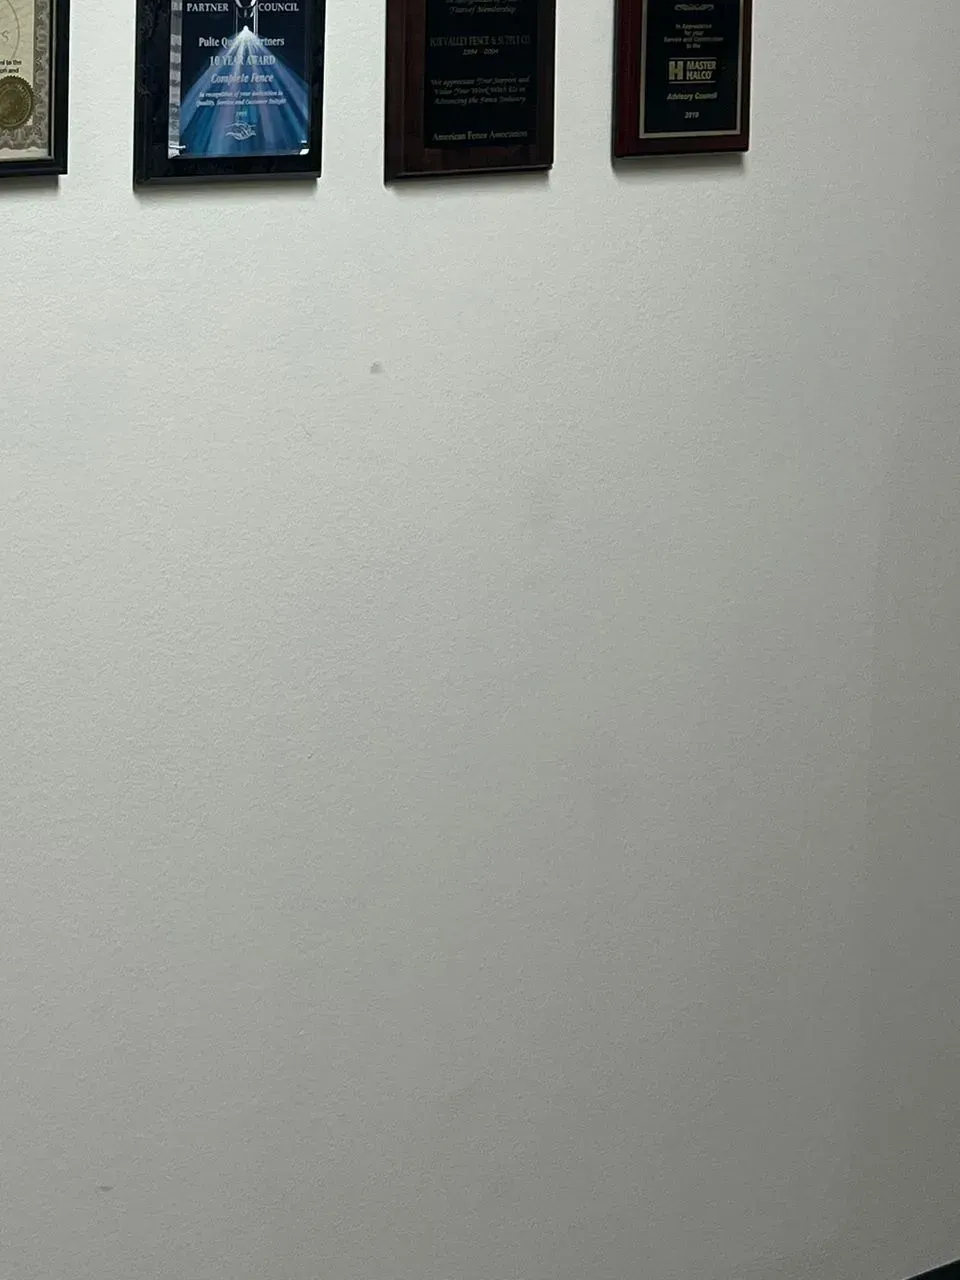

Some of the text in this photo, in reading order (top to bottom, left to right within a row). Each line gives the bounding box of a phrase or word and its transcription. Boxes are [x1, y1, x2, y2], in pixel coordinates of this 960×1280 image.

[186, 2, 299, 12] PARTNER COUNCIL
[198, 36, 220, 47] Pulte
[210, 55, 276, 66] 10 YEAR AWARD
[686, 60, 716, 70] MASTER
[211, 73, 274, 85] Complete Fence
[686, 70, 713, 80] HALCO
[666, 92, 694, 102] Advisory
[432, 130, 528, 141] American Fence Association
